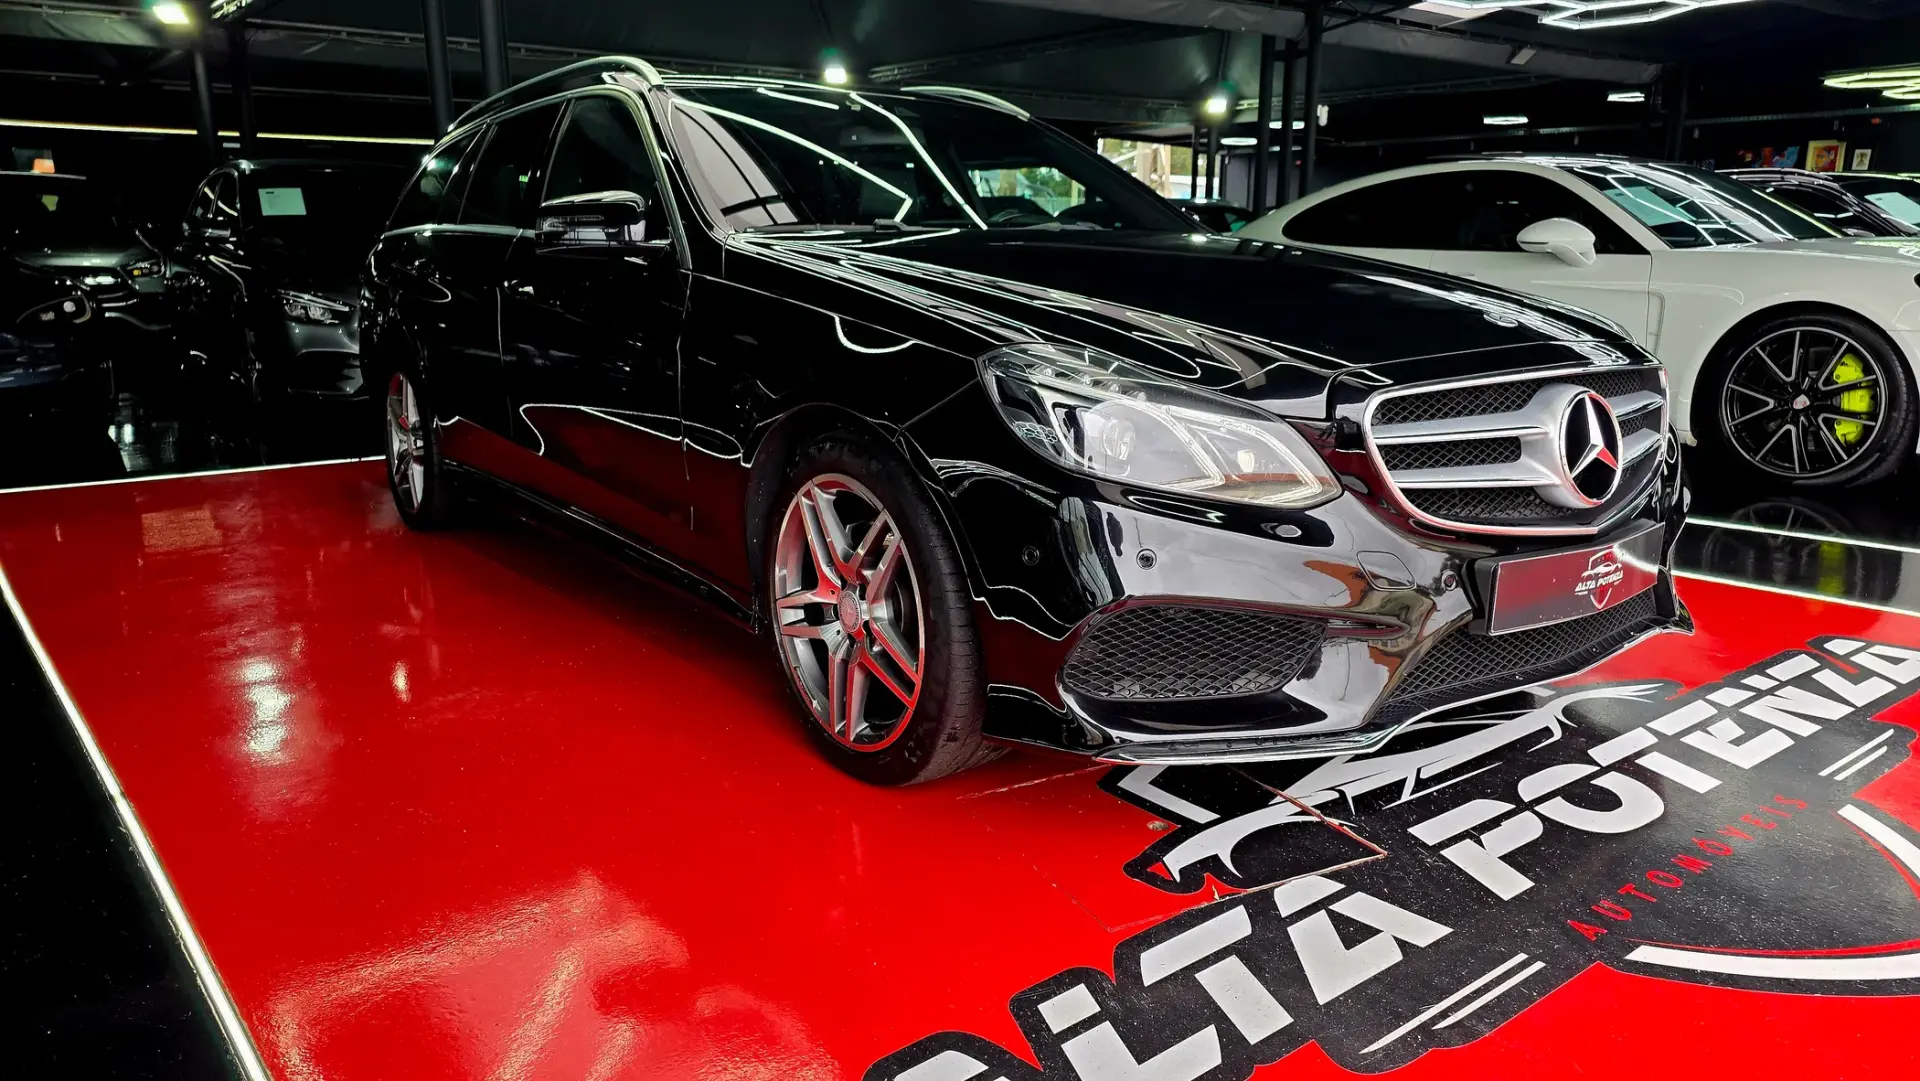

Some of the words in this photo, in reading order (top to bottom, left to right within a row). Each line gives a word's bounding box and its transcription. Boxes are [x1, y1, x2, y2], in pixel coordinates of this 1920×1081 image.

[1574, 580, 1596, 592] ALTA
[893, 874, 1454, 1081] LTA
[1407, 638, 1920, 901] POTENZA
[1566, 795, 1808, 942] AUTOMÓVEIS
